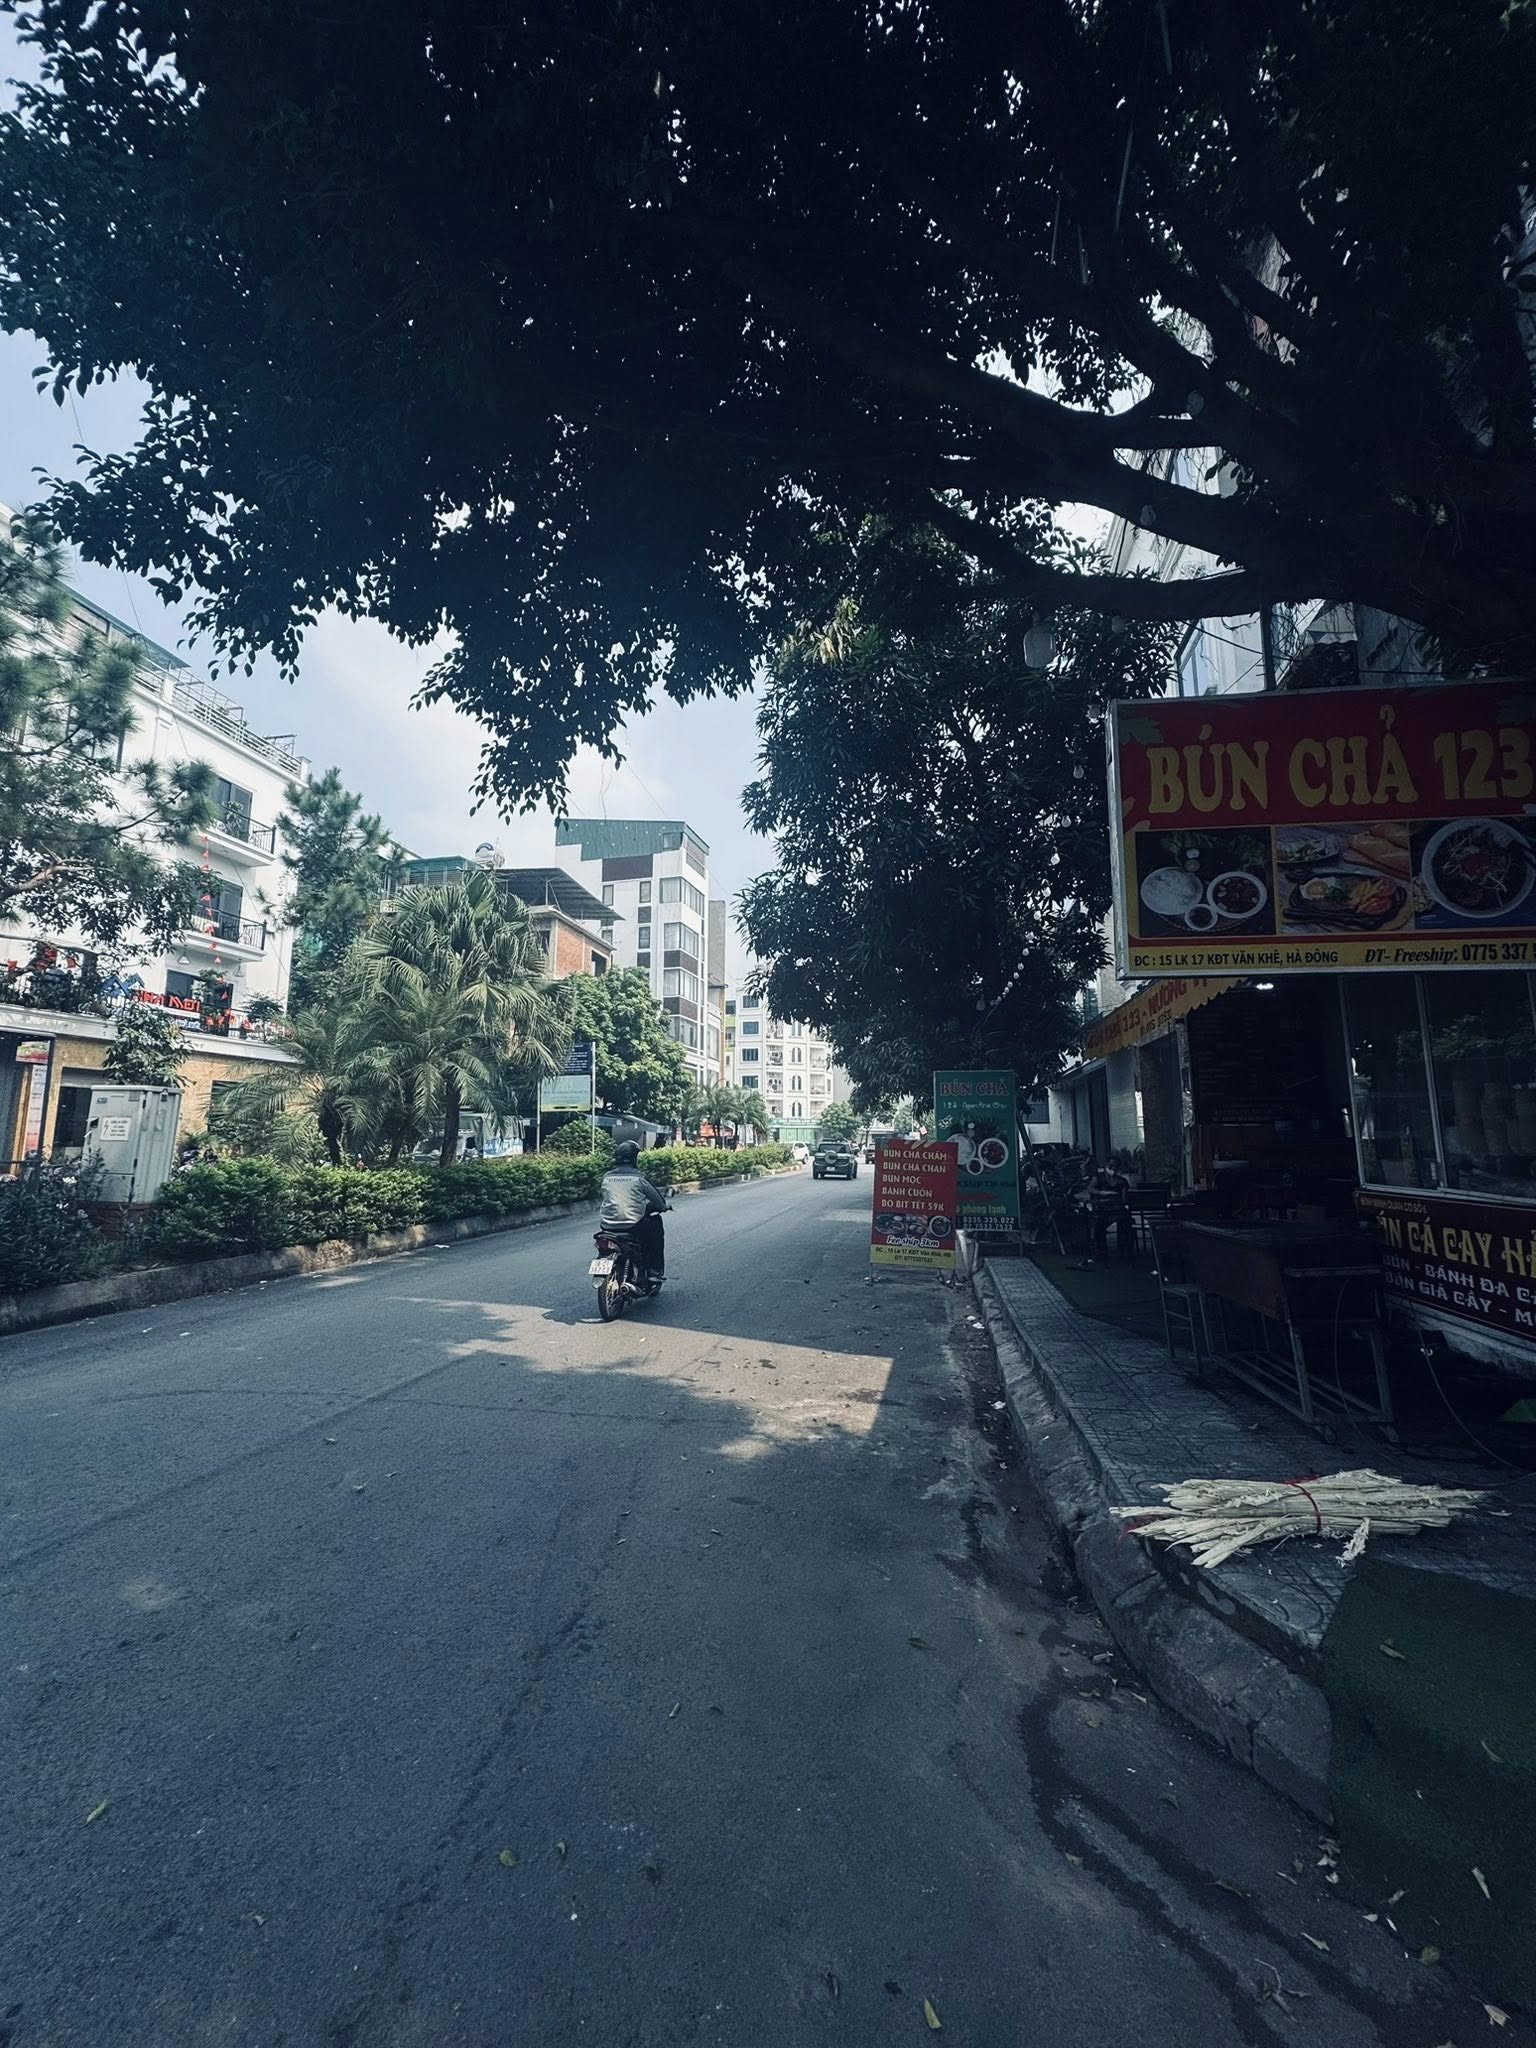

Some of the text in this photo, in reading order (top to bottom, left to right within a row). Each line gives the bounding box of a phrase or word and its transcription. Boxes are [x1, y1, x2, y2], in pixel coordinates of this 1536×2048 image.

[1146, 704, 1534, 814] BÚN CHẢ 123
[1134, 955, 1150, 966] ĐC
[1159, 954, 1172, 966] 15
[1175, 954, 1189, 965] LK
[1192, 954, 1204, 965] 17
[1207, 953, 1230, 965] KĐT
[1232, 951, 1255, 964] VĂN
[1258, 950, 1283, 966] KHÊ,
[1287, 949, 1301, 963] HÀ
[1305, 948, 1339, 963] ĐÔNG
[1462, 943, 1497, 961] 0775
[1501, 942, 1528, 960] 337
[1123, 1008, 1140, 1032] 123
[940, 1078, 1010, 1096] BÚN CHẢ
[928, 1202, 944, 1211] 59K
[902, 1236, 920, 1247] ship
[920, 1238, 939, 1247] 3km
[1407, 1216, 1438, 1257] CÁ
[1442, 1227, 1492, 1269] CAY
[1424, 1263, 1475, 1289] BÁNH
[1480, 1277, 1510, 1298] ĐA
[1453, 1290, 1492, 1313] CẦY
